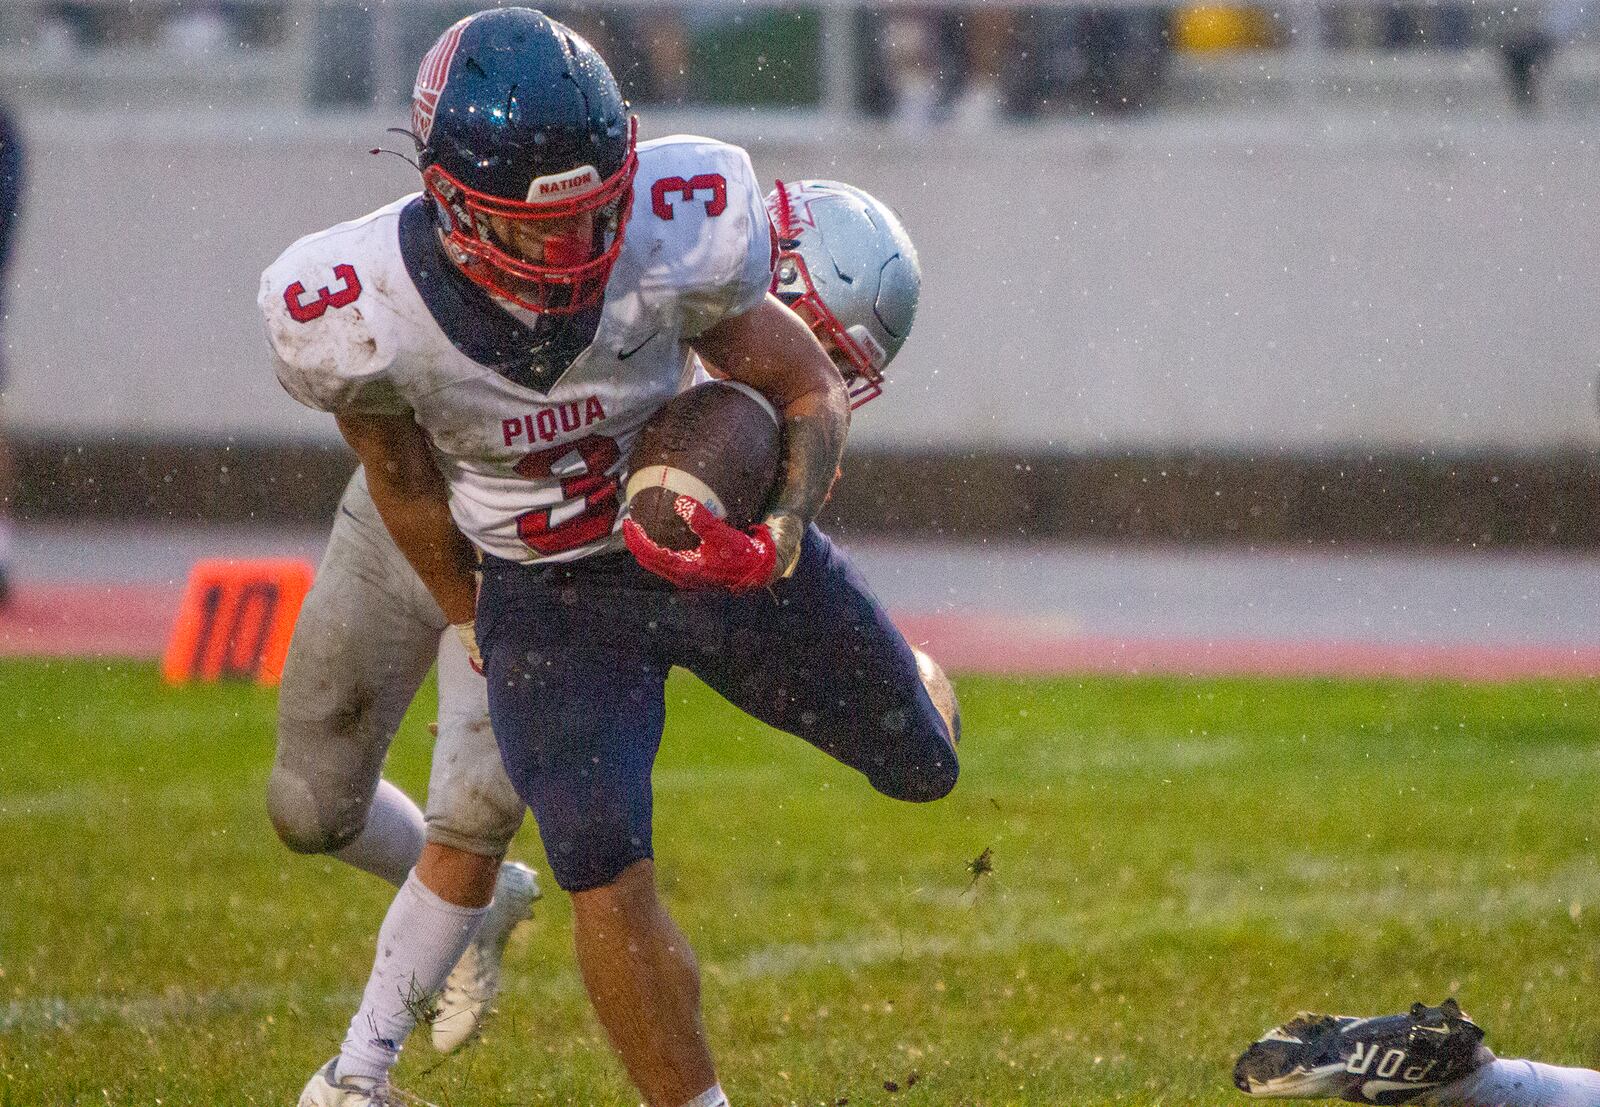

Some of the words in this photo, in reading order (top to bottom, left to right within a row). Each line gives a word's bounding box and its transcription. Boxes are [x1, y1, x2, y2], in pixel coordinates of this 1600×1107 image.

[540, 172, 592, 194] NATION
[651, 173, 727, 221] 3
[283, 263, 363, 324] 3
[501, 394, 606, 447] PIQUA
[512, 433, 621, 556] 3
[190, 582, 280, 682] 10
